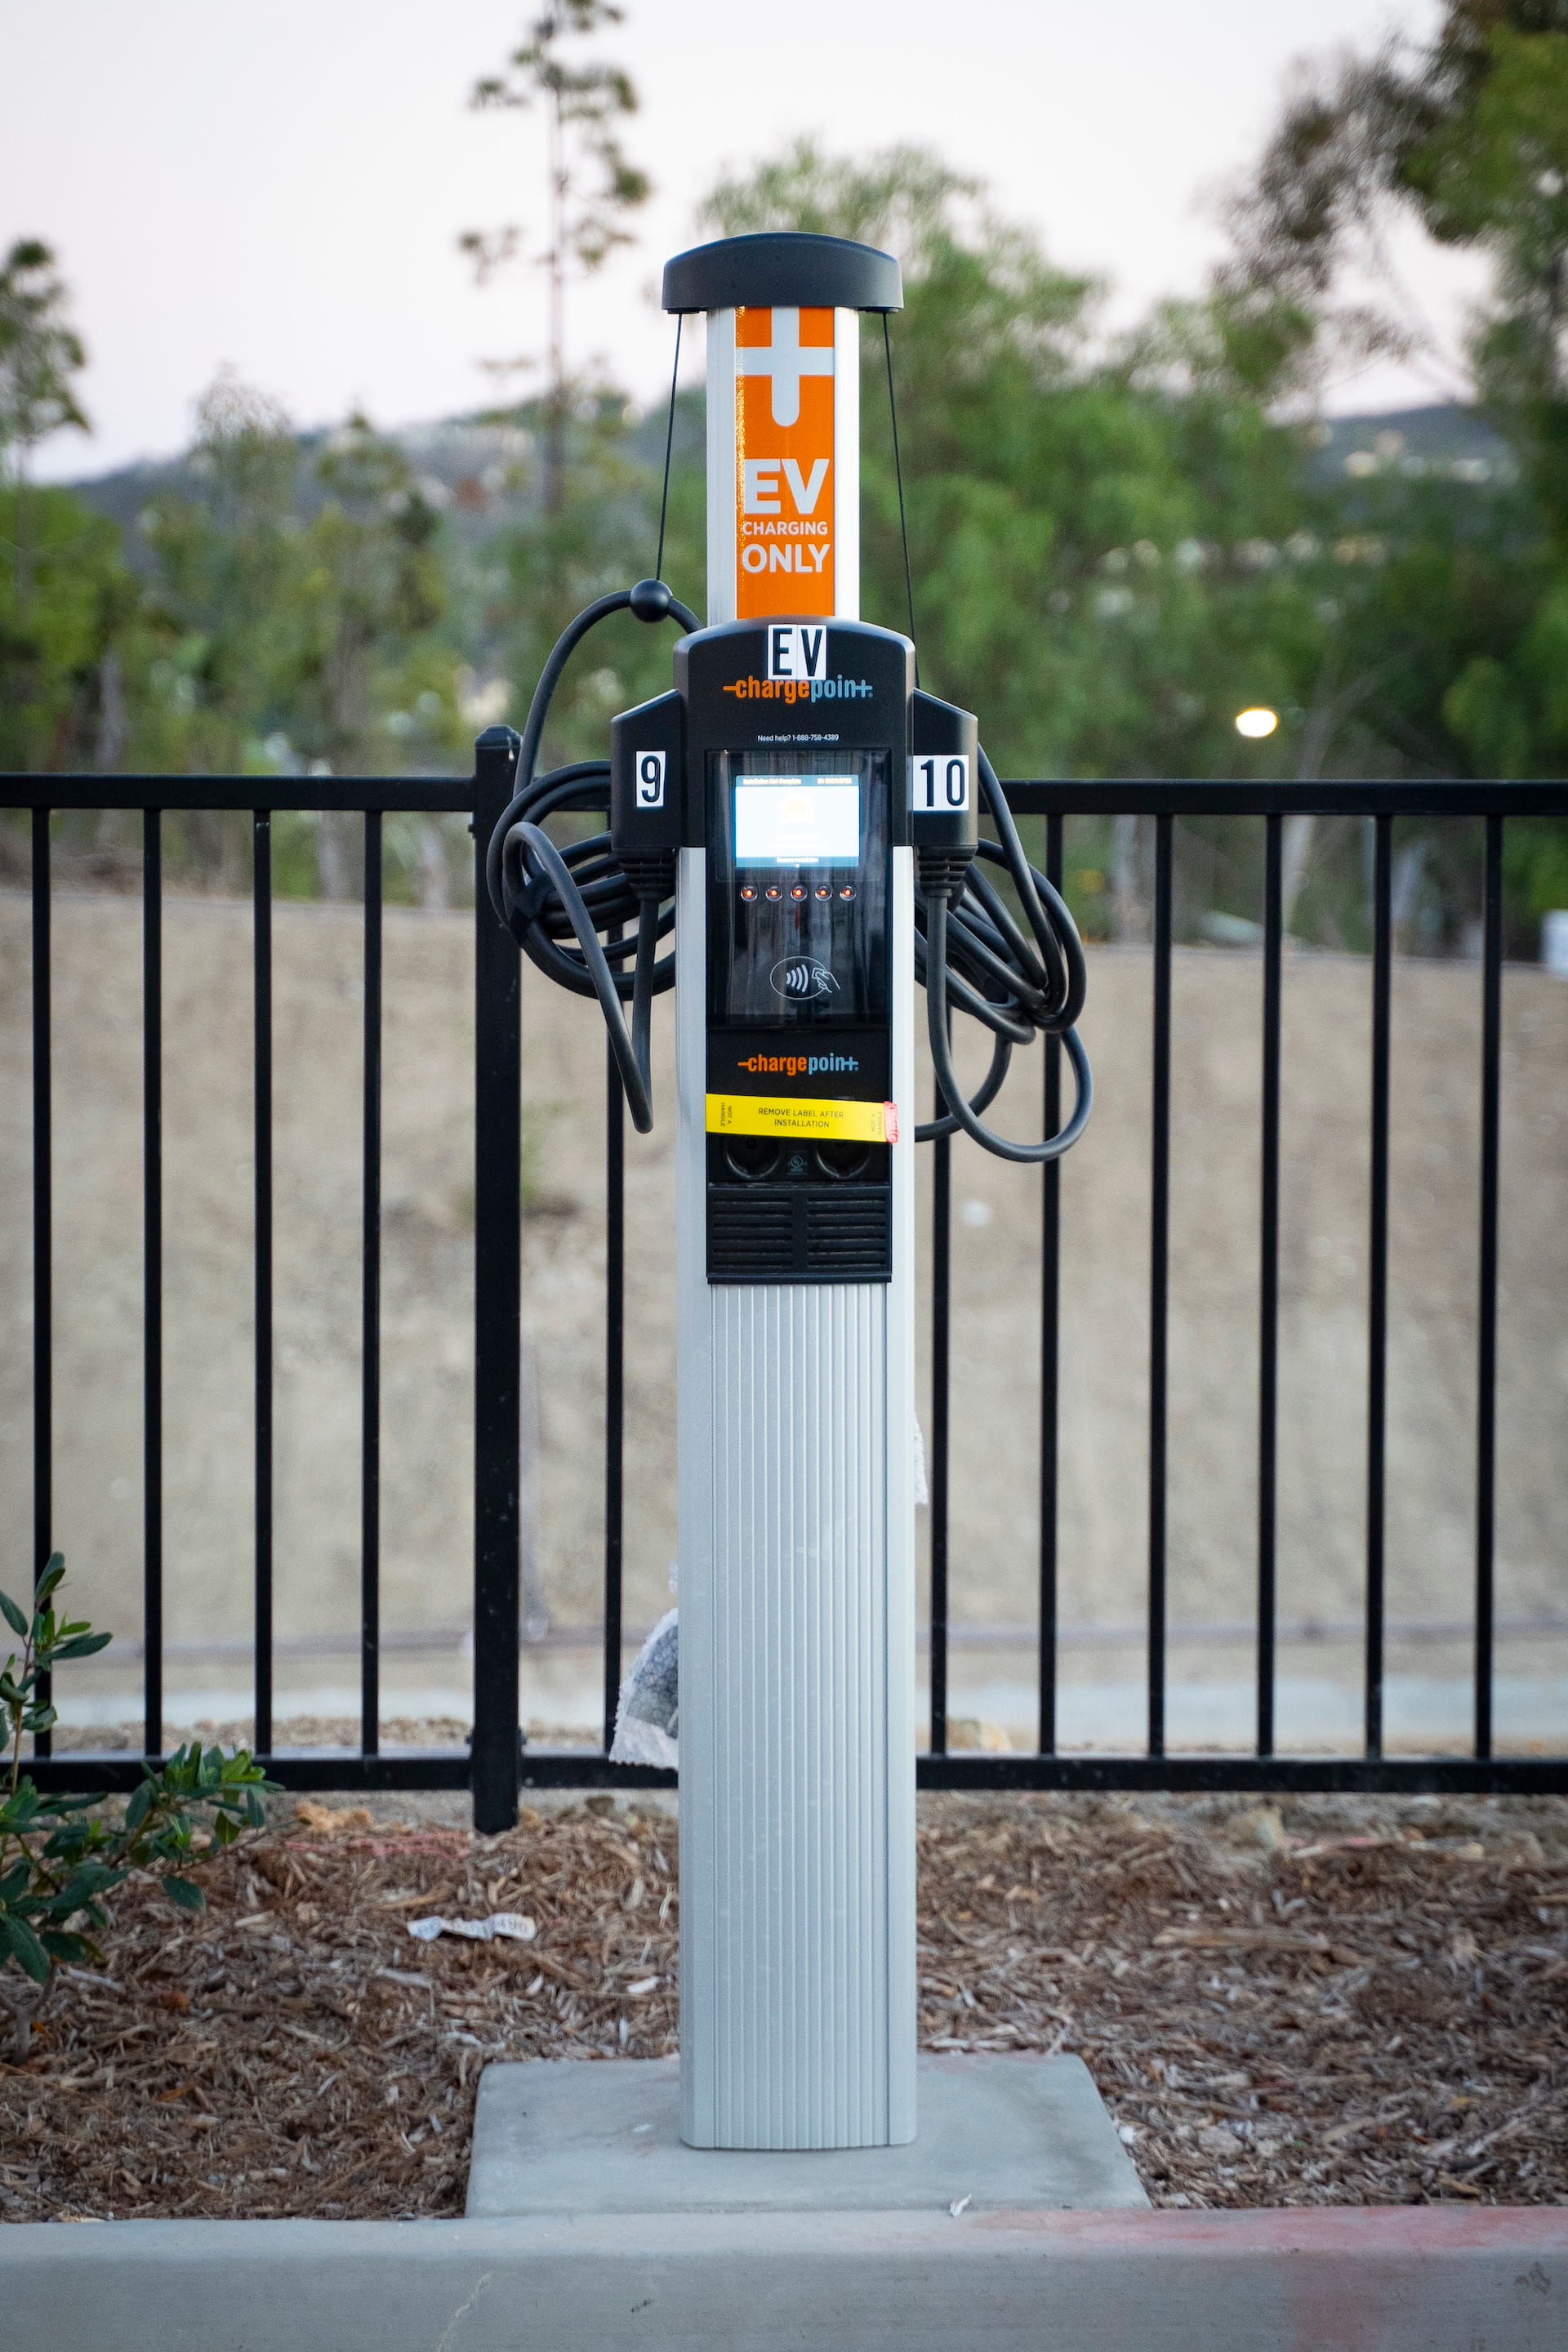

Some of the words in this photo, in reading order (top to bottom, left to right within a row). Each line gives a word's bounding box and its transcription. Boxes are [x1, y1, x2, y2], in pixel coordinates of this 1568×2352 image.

[744, 459, 830, 514] EV
[742, 521, 828, 536] CHARGING
[742, 543, 831, 573] ONLY
[773, 627, 823, 677] EV
[775, 734, 791, 742] help?
[792, 733, 840, 742] 1-888-758-4389
[640, 755, 661, 803] 9
[920, 758, 965, 808] 10
[758, 1107, 791, 1116] REMOVE
[792, 1109, 817, 1117] LABEL
[774, 1118, 830, 1128] INSTALLATION
